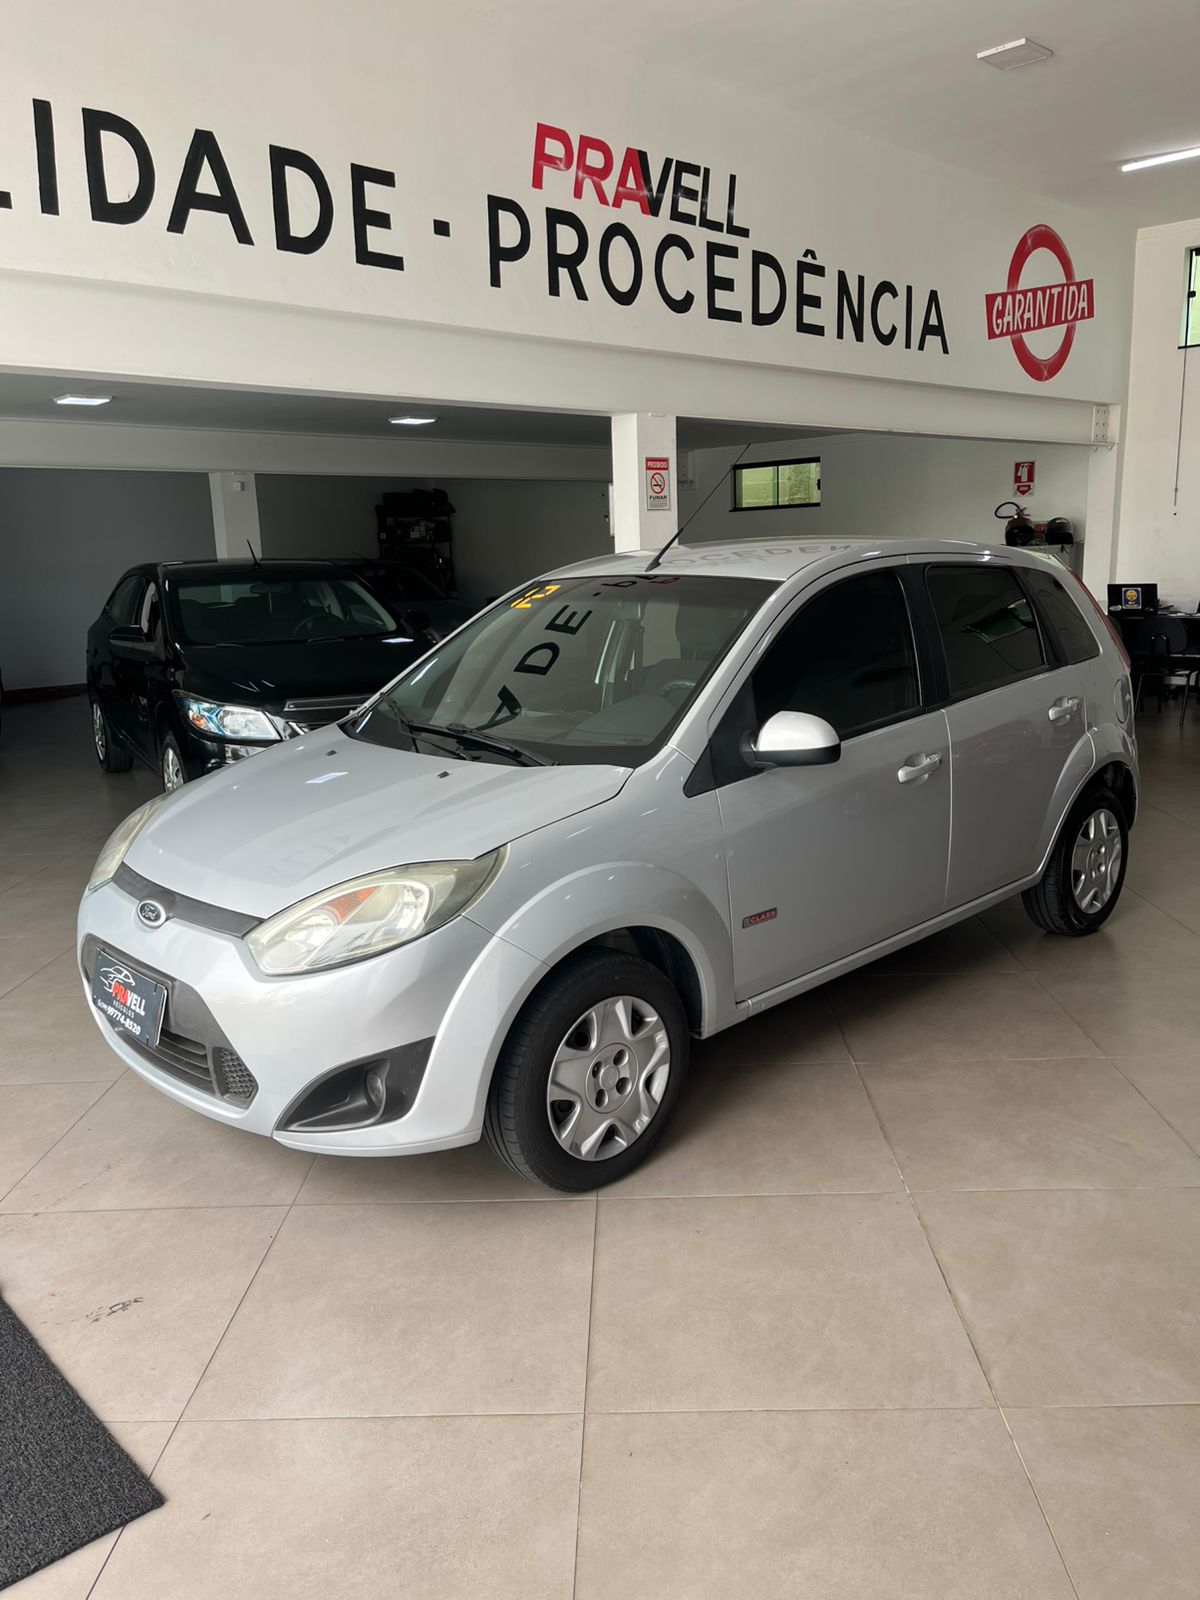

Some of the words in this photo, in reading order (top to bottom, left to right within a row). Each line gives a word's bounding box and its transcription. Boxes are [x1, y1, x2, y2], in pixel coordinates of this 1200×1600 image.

[531, 122, 750, 238] PRAVELL
[0, 98, 405, 272] IDADE
[486, 193, 950, 355] PROCEDÊNCIA
[992, 283, 1089, 336] GARANTIDA
[111, 981, 145, 1016] PRAVELL
